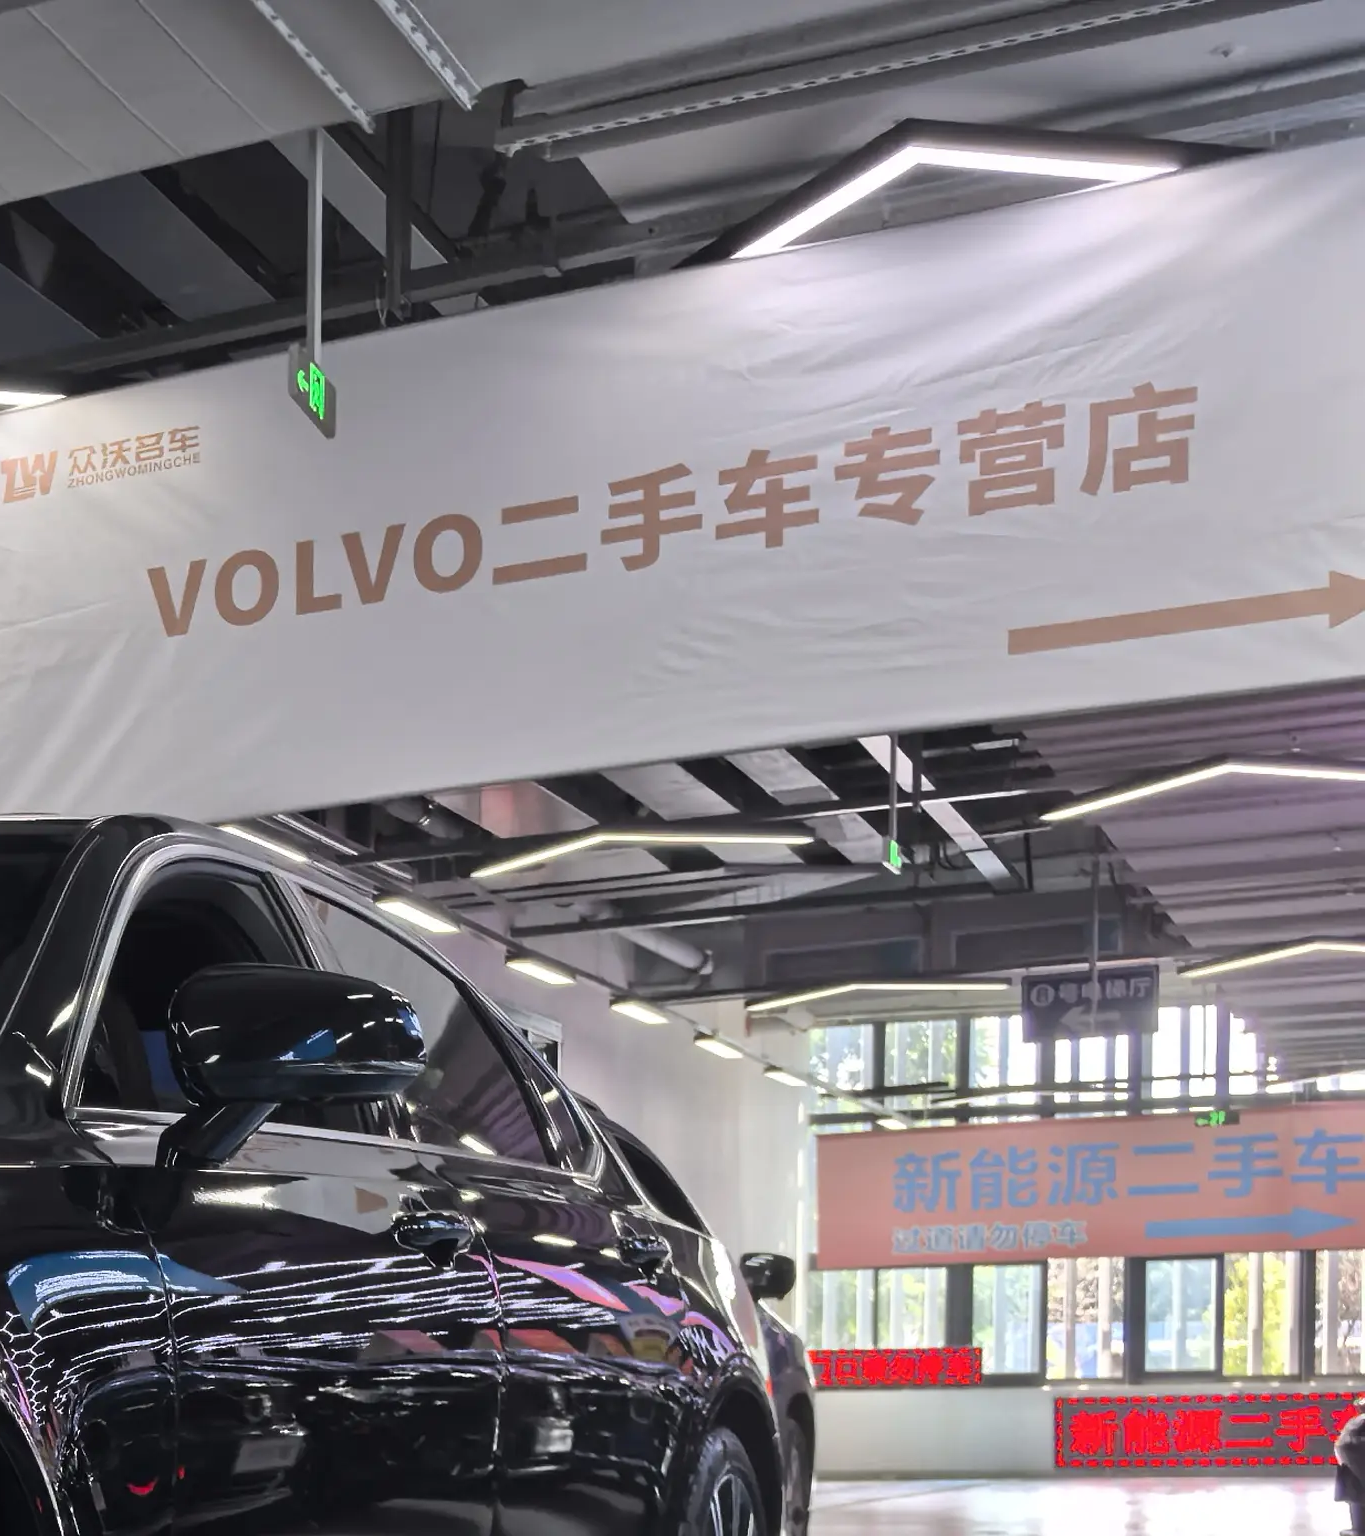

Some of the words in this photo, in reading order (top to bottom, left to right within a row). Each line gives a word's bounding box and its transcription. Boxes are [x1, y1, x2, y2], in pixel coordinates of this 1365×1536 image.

[67, 451, 201, 489] ZHONGWOMINGCHE
[68, 425, 201, 477] 众沃名车
[147, 381, 1199, 638] VOLVO二手车专营店
[891, 1128, 1365, 1214] 新能源二手车
[891, 1219, 1088, 1255] 过道请勿停车
